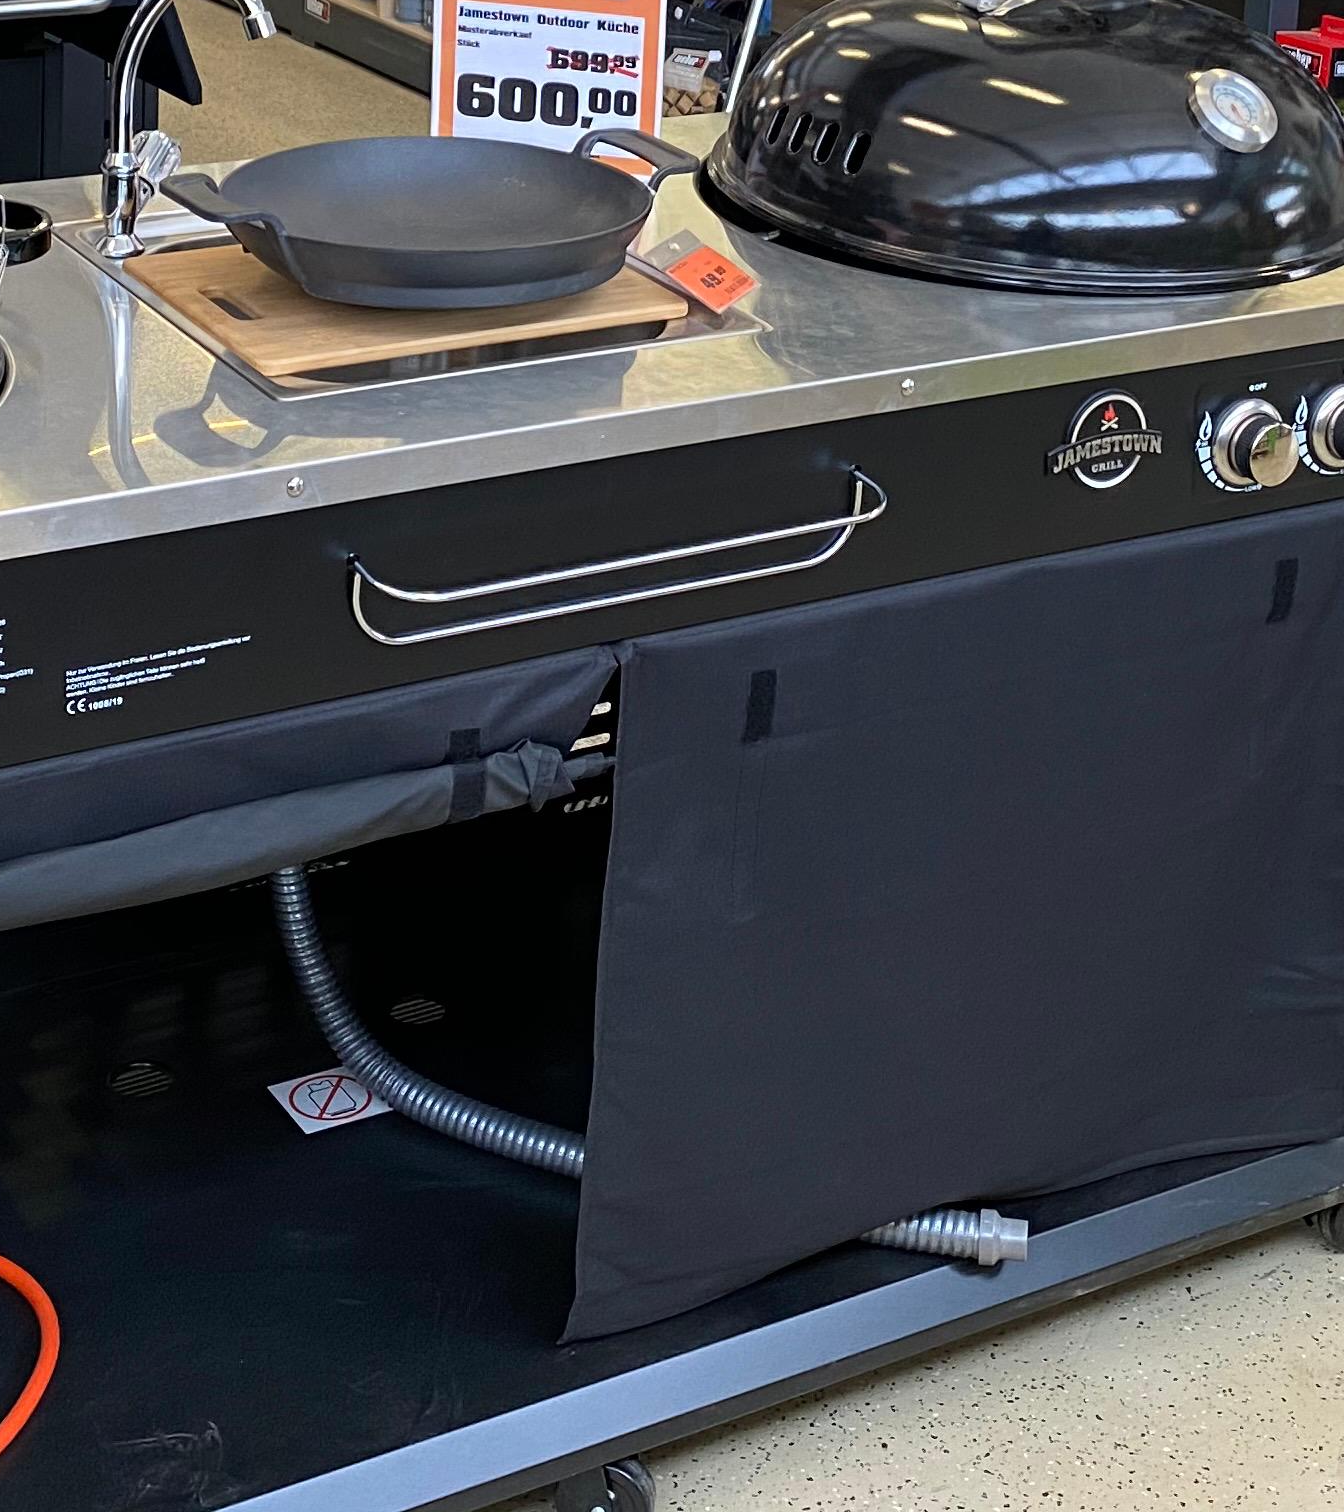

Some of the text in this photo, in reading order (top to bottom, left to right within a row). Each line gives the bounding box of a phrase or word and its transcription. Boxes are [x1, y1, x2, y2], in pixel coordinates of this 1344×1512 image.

[458, 5, 639, 35] Jamestown Outdoor Küche
[456, 38, 481, 49] Stück
[457, 72, 638, 129] 600,00
[1053, 433, 1163, 476] JAMESTOWN
[1091, 459, 1124, 473] GRILL
